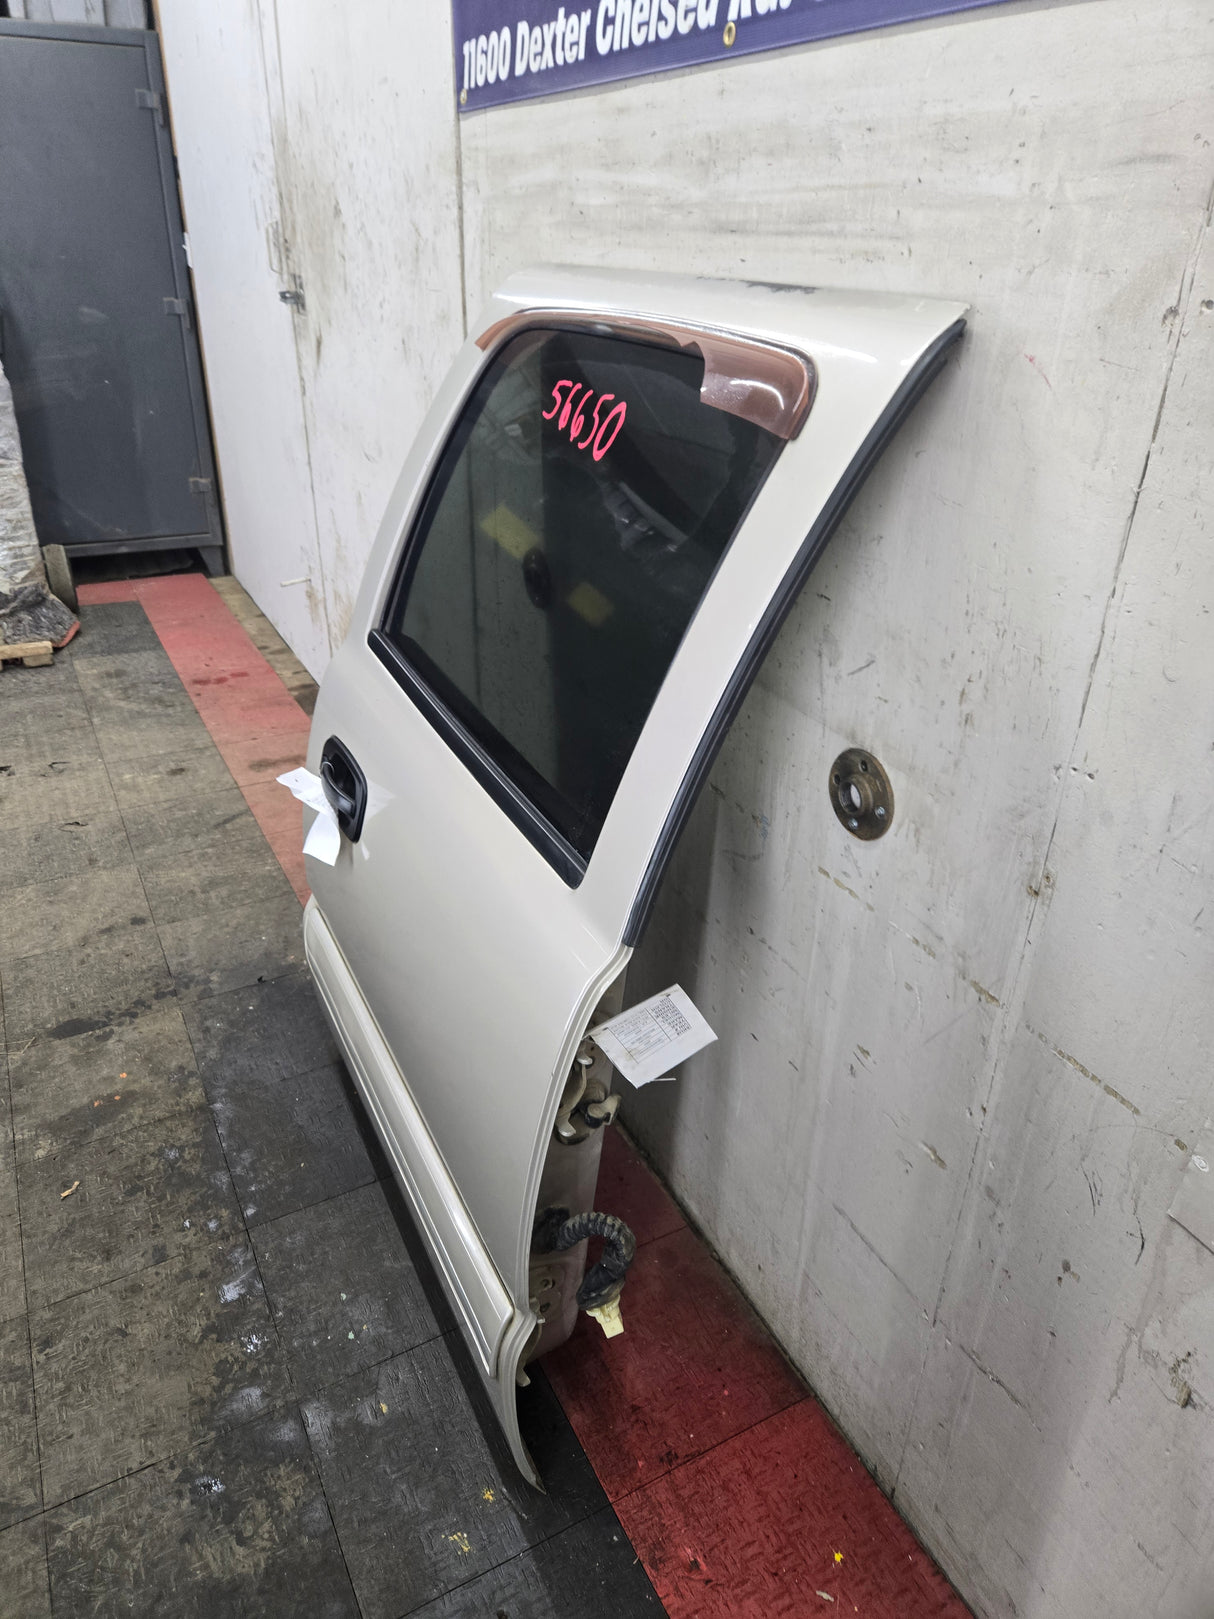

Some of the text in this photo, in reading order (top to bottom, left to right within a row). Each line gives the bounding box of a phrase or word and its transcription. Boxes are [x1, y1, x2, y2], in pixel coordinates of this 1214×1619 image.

[463, 26, 512, 90] 11600
[514, 7, 592, 77] Dexter
[541, 379, 628, 462] 56650
